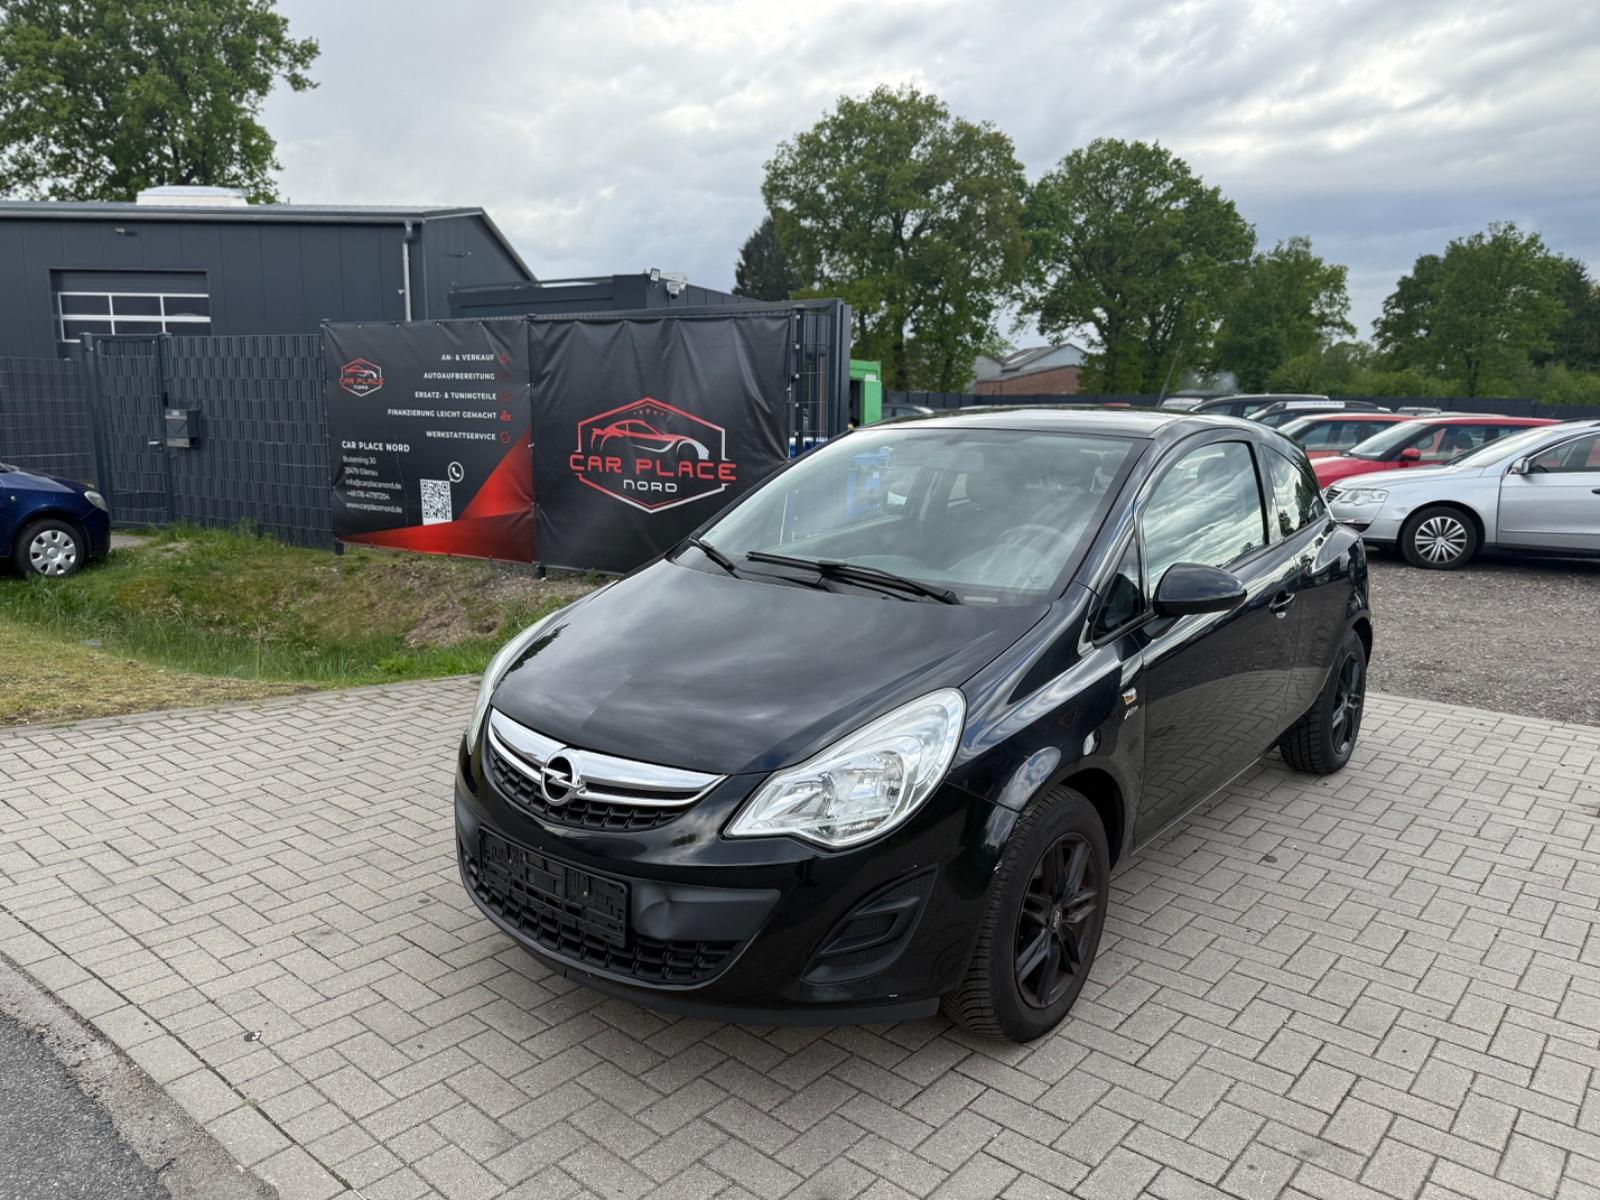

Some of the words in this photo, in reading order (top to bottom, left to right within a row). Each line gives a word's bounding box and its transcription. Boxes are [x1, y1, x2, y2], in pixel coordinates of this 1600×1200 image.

[423, 372, 495, 380] AUTOAUFBEREITUNG
[415, 391, 442, 399] ERSATZ-
[450, 392, 497, 400] TUNINGTEILE
[387, 408, 435, 417] FINANZIERUNG
[436, 410, 460, 418] LEICHT
[462, 411, 497, 419] GEMACHT
[426, 431, 496, 440] WERKSTATTSERVICE
[341, 440, 357, 449] CAR
[358, 441, 384, 451] PLACE
[385, 443, 410, 452] NORD
[569, 453, 622, 474] CAR
[636, 457, 737, 481] PLACE
